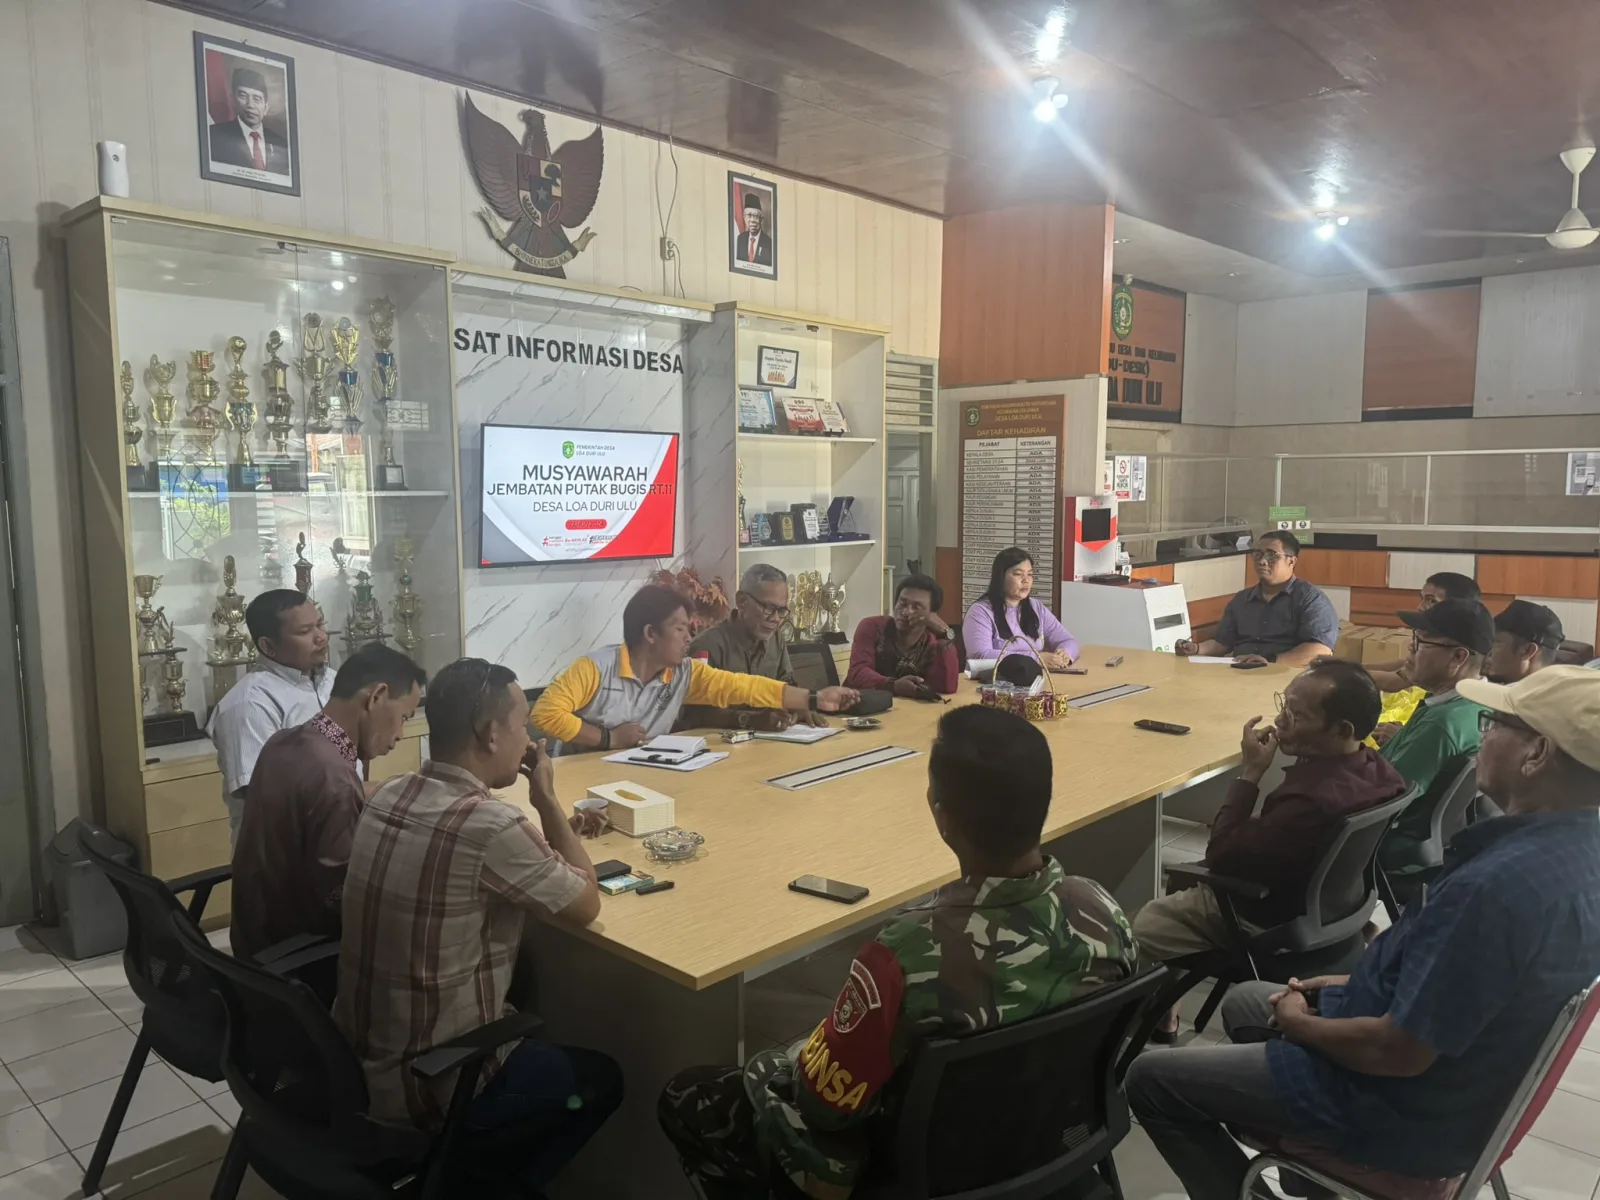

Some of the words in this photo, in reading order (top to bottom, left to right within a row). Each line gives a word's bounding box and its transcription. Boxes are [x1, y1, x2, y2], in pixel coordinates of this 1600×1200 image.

[453, 327, 501, 356] SAT
[507, 335, 629, 369] INFORMASI
[633, 350, 684, 375] DESA
[976, 428, 1004, 437] DAFTAR
[1004, 426, 1047, 435] KEHADIRAN
[522, 464, 648, 481] MUSYAWARAH
[487, 483, 563, 496] JEMBATAN
[565, 483, 609, 495] PUTAK
[610, 484, 647, 495] BUGIS
[649, 484, 672, 495] RT.11
[533, 501, 563, 512] DESA
[565, 501, 588, 512] LOA
[590, 501, 615, 511] DURI
[616, 501, 638, 511] ULU
